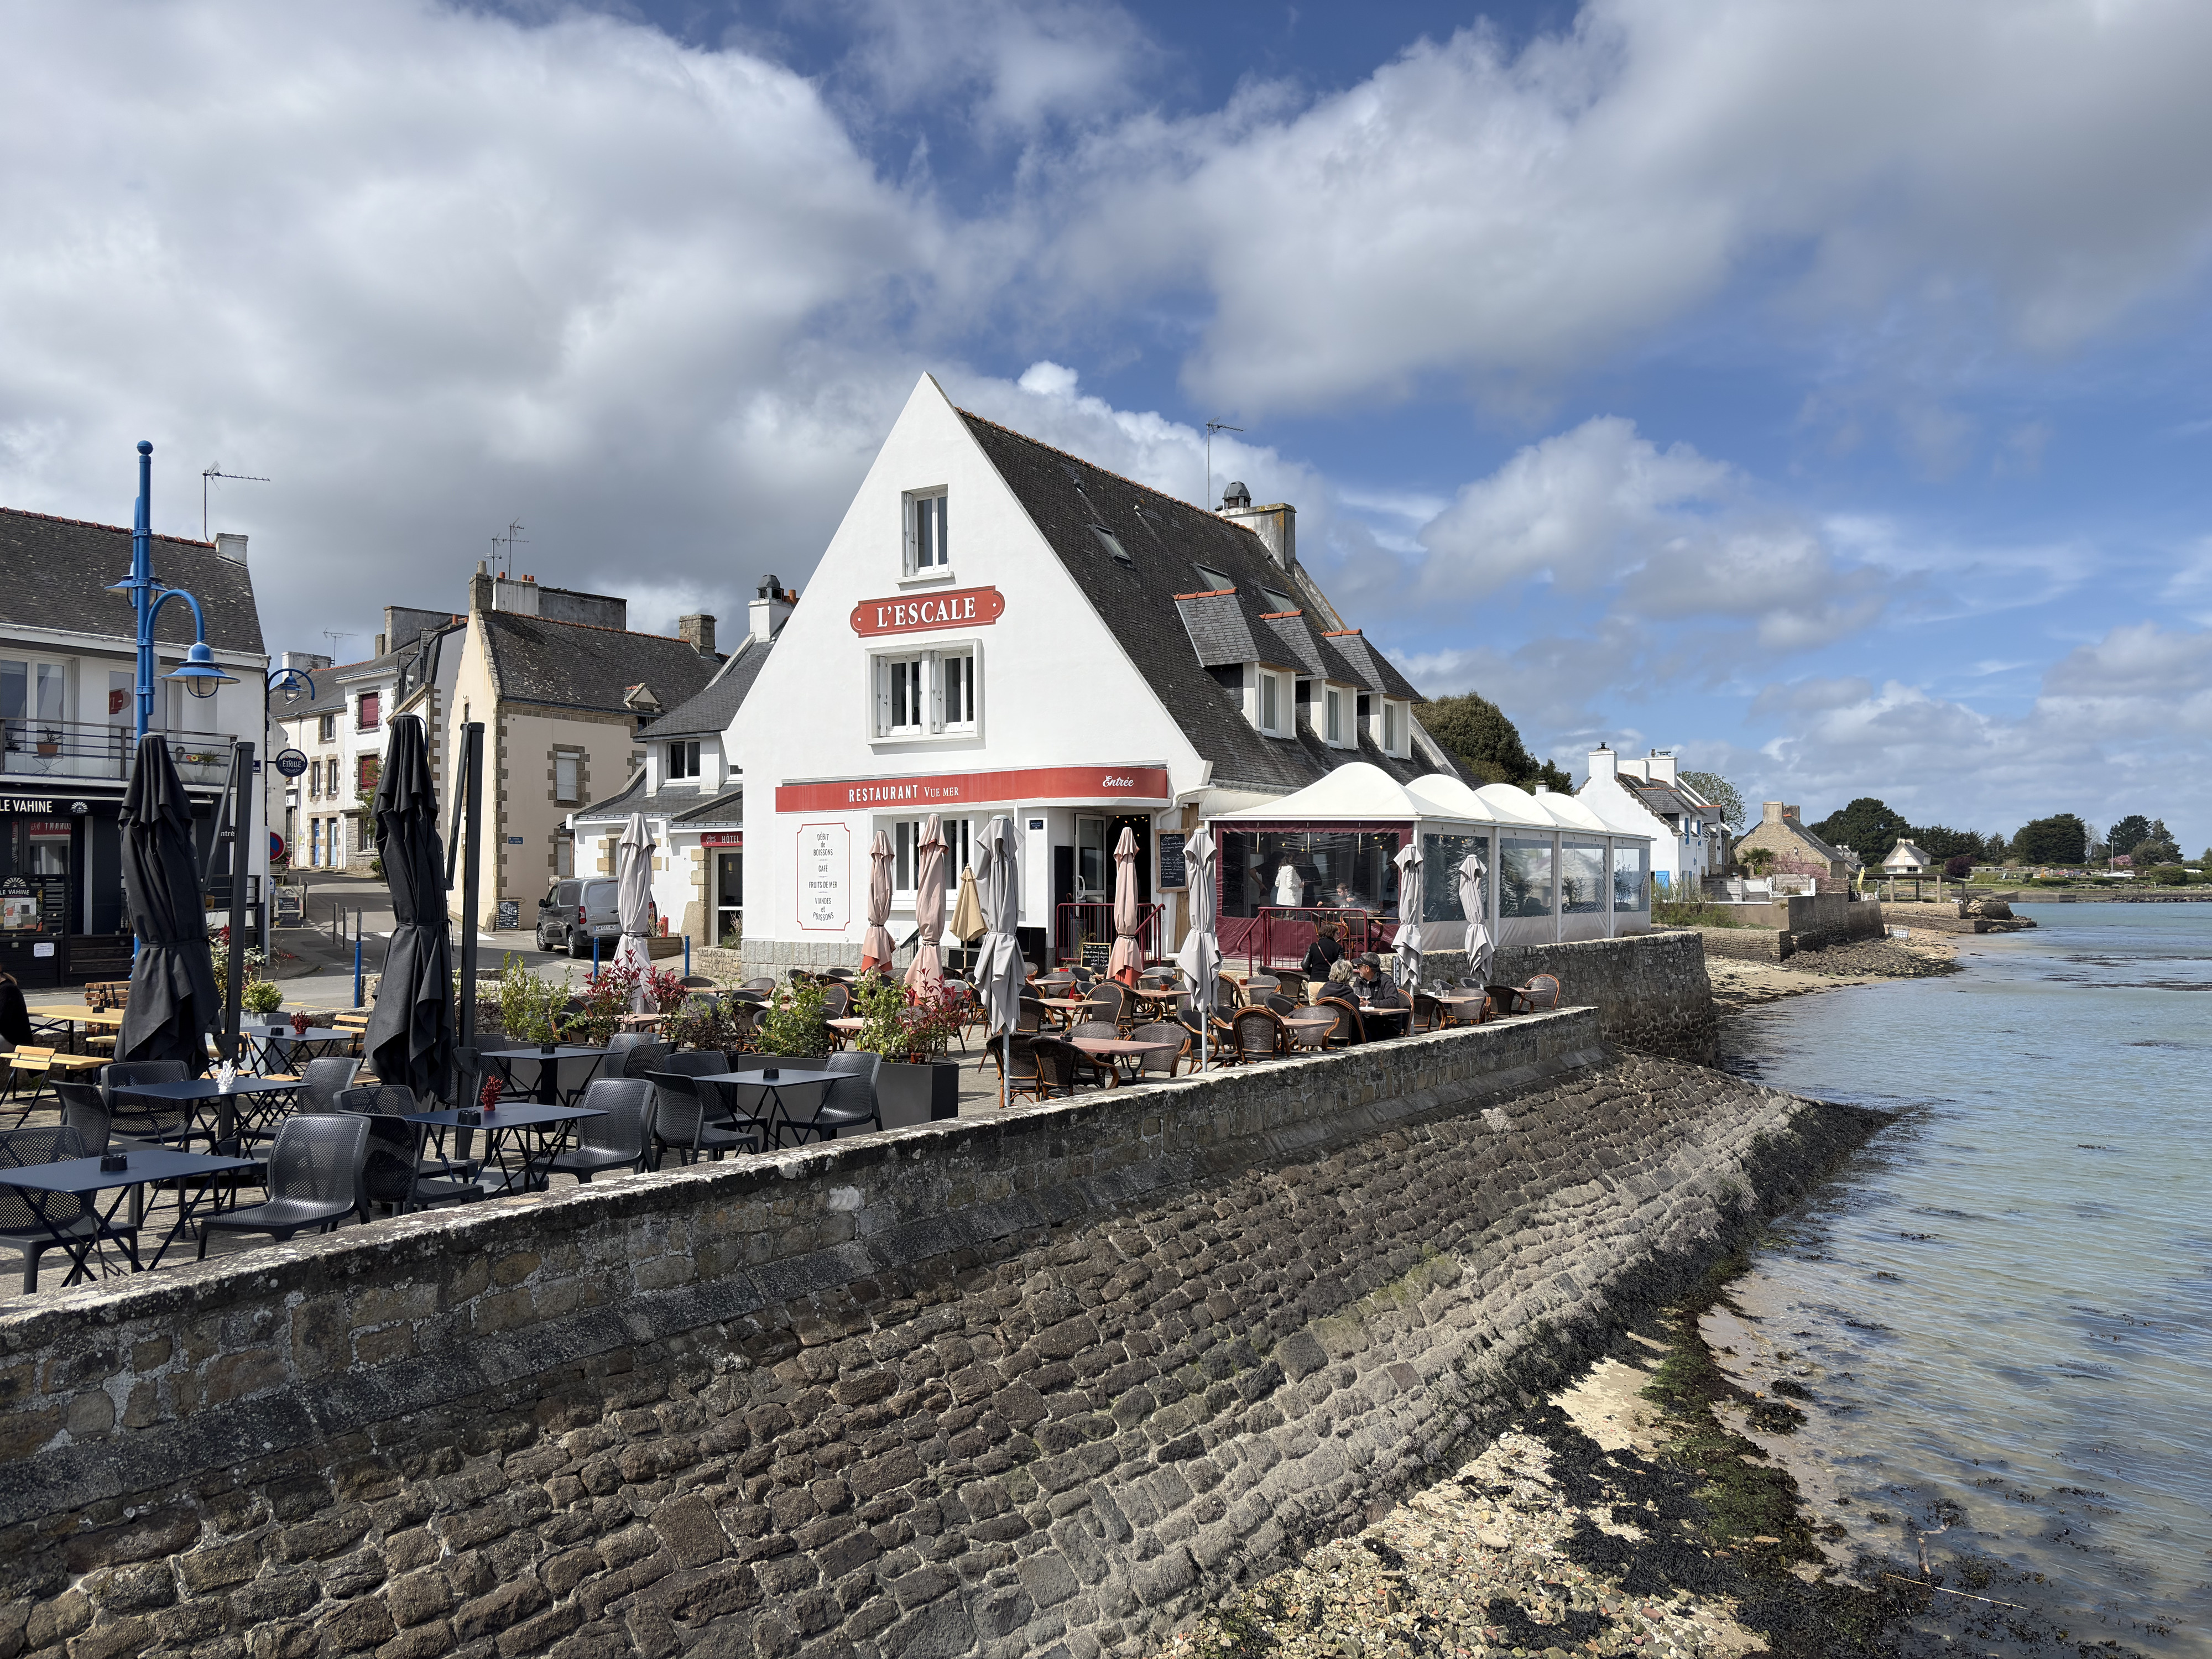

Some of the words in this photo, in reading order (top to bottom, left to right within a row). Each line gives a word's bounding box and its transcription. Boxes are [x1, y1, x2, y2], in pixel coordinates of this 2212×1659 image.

[877, 597, 976, 628] L'ESCALE
[1102, 775, 1134, 787] Entrée
[849, 785, 918, 802] RESTAURANT
[13, 800, 53, 813] VAHINE
[722, 833, 740, 843] HÔTEL
[817, 832, 830, 841] DÉBIT
[818, 863, 828, 872] CAFÉ
[812, 912, 834, 921] POISSONS
